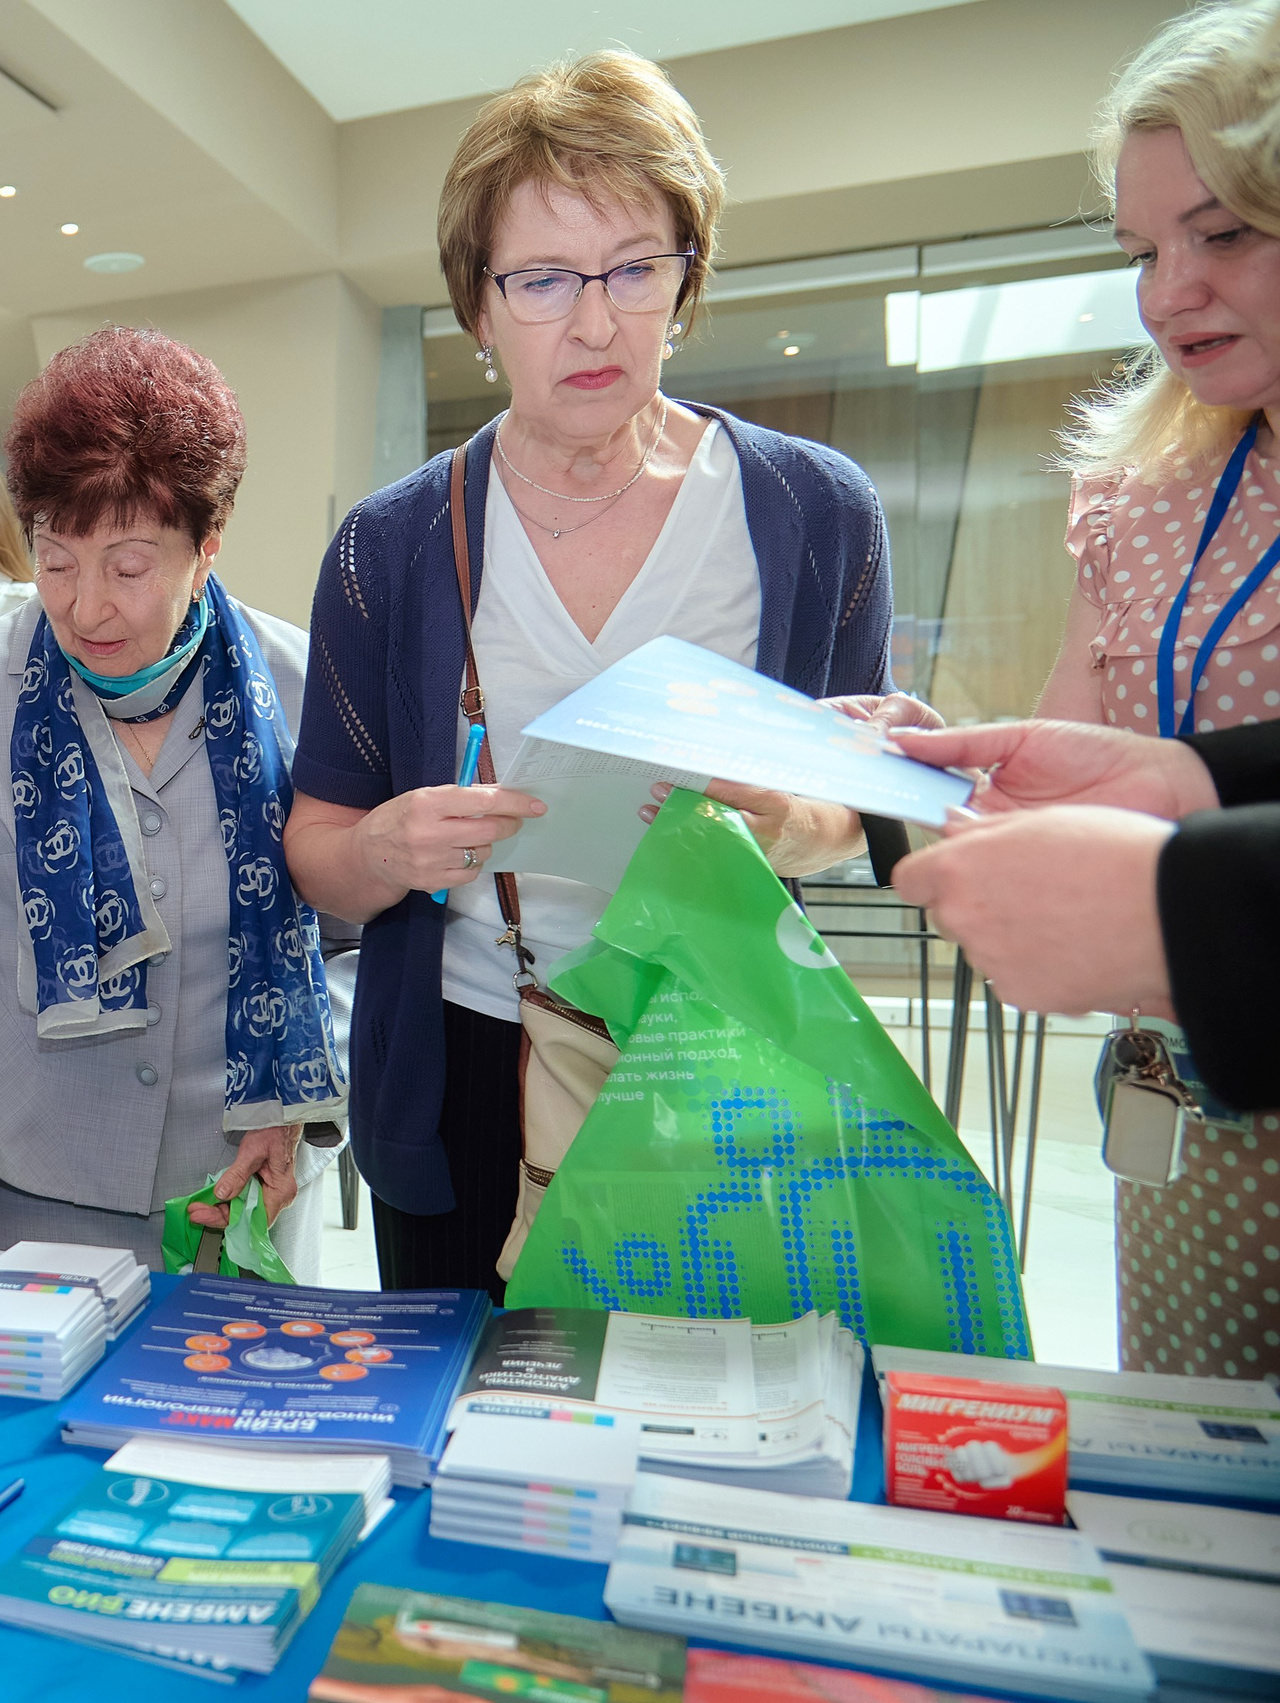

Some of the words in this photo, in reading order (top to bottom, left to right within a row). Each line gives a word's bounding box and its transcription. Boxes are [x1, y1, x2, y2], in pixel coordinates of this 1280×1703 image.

[638, 1013, 678, 1027] ауки,
[668, 1028, 746, 1045] практики
[677, 1047, 742, 1062] подход,
[646, 1070, 695, 1080] жизнь
[102, 1394, 238, 1417] НЕВРОЛОГИИ
[896, 1393, 1054, 1424] МИГРЕНИУМ
[259, 1411, 395, 1424] ИННОВАЦИЯ
[48, 1585, 123, 1614] БИО
[652, 1585, 863, 1634] АМБЕНЕ
[126, 1600, 278, 1623] АМБЕНЕ
